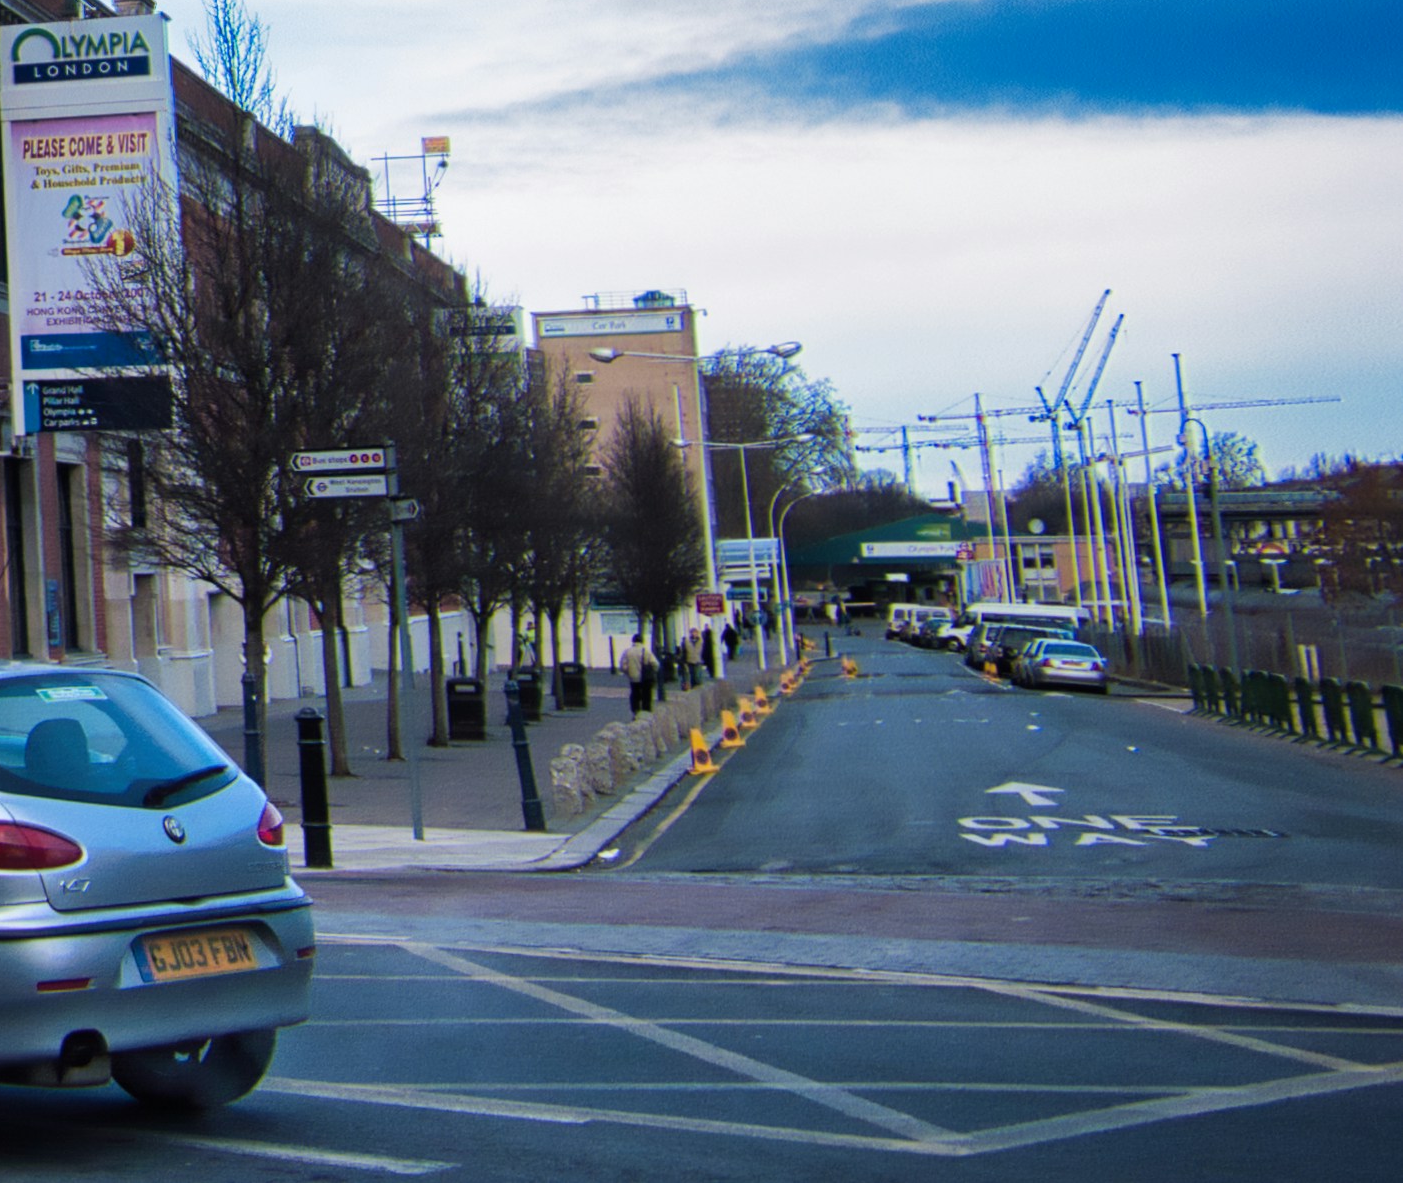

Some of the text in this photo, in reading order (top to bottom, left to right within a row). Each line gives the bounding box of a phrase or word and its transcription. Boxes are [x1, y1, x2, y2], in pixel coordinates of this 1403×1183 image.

[11, 27, 151, 62] OLYMPIA
[34, 60, 129, 78] LONDON
[22, 132, 148, 160] PLEASE COME & VISIT
[35, 162, 141, 177] Toys, Gifts, Premium
[31, 179, 41, 189] &
[43, 177, 97, 189] Household
[33, 291, 47, 302] 21
[58, 290, 72, 301] 24
[26, 307, 55, 316] HONG
[57, 306, 85, 315] KONG
[67, 384, 83, 394] Hall
[43, 408, 76, 418] Olympia
[957, 814, 1201, 836] ONE
[959, 832, 1218, 847] WAY
[149, 938, 208, 974] GJ03
